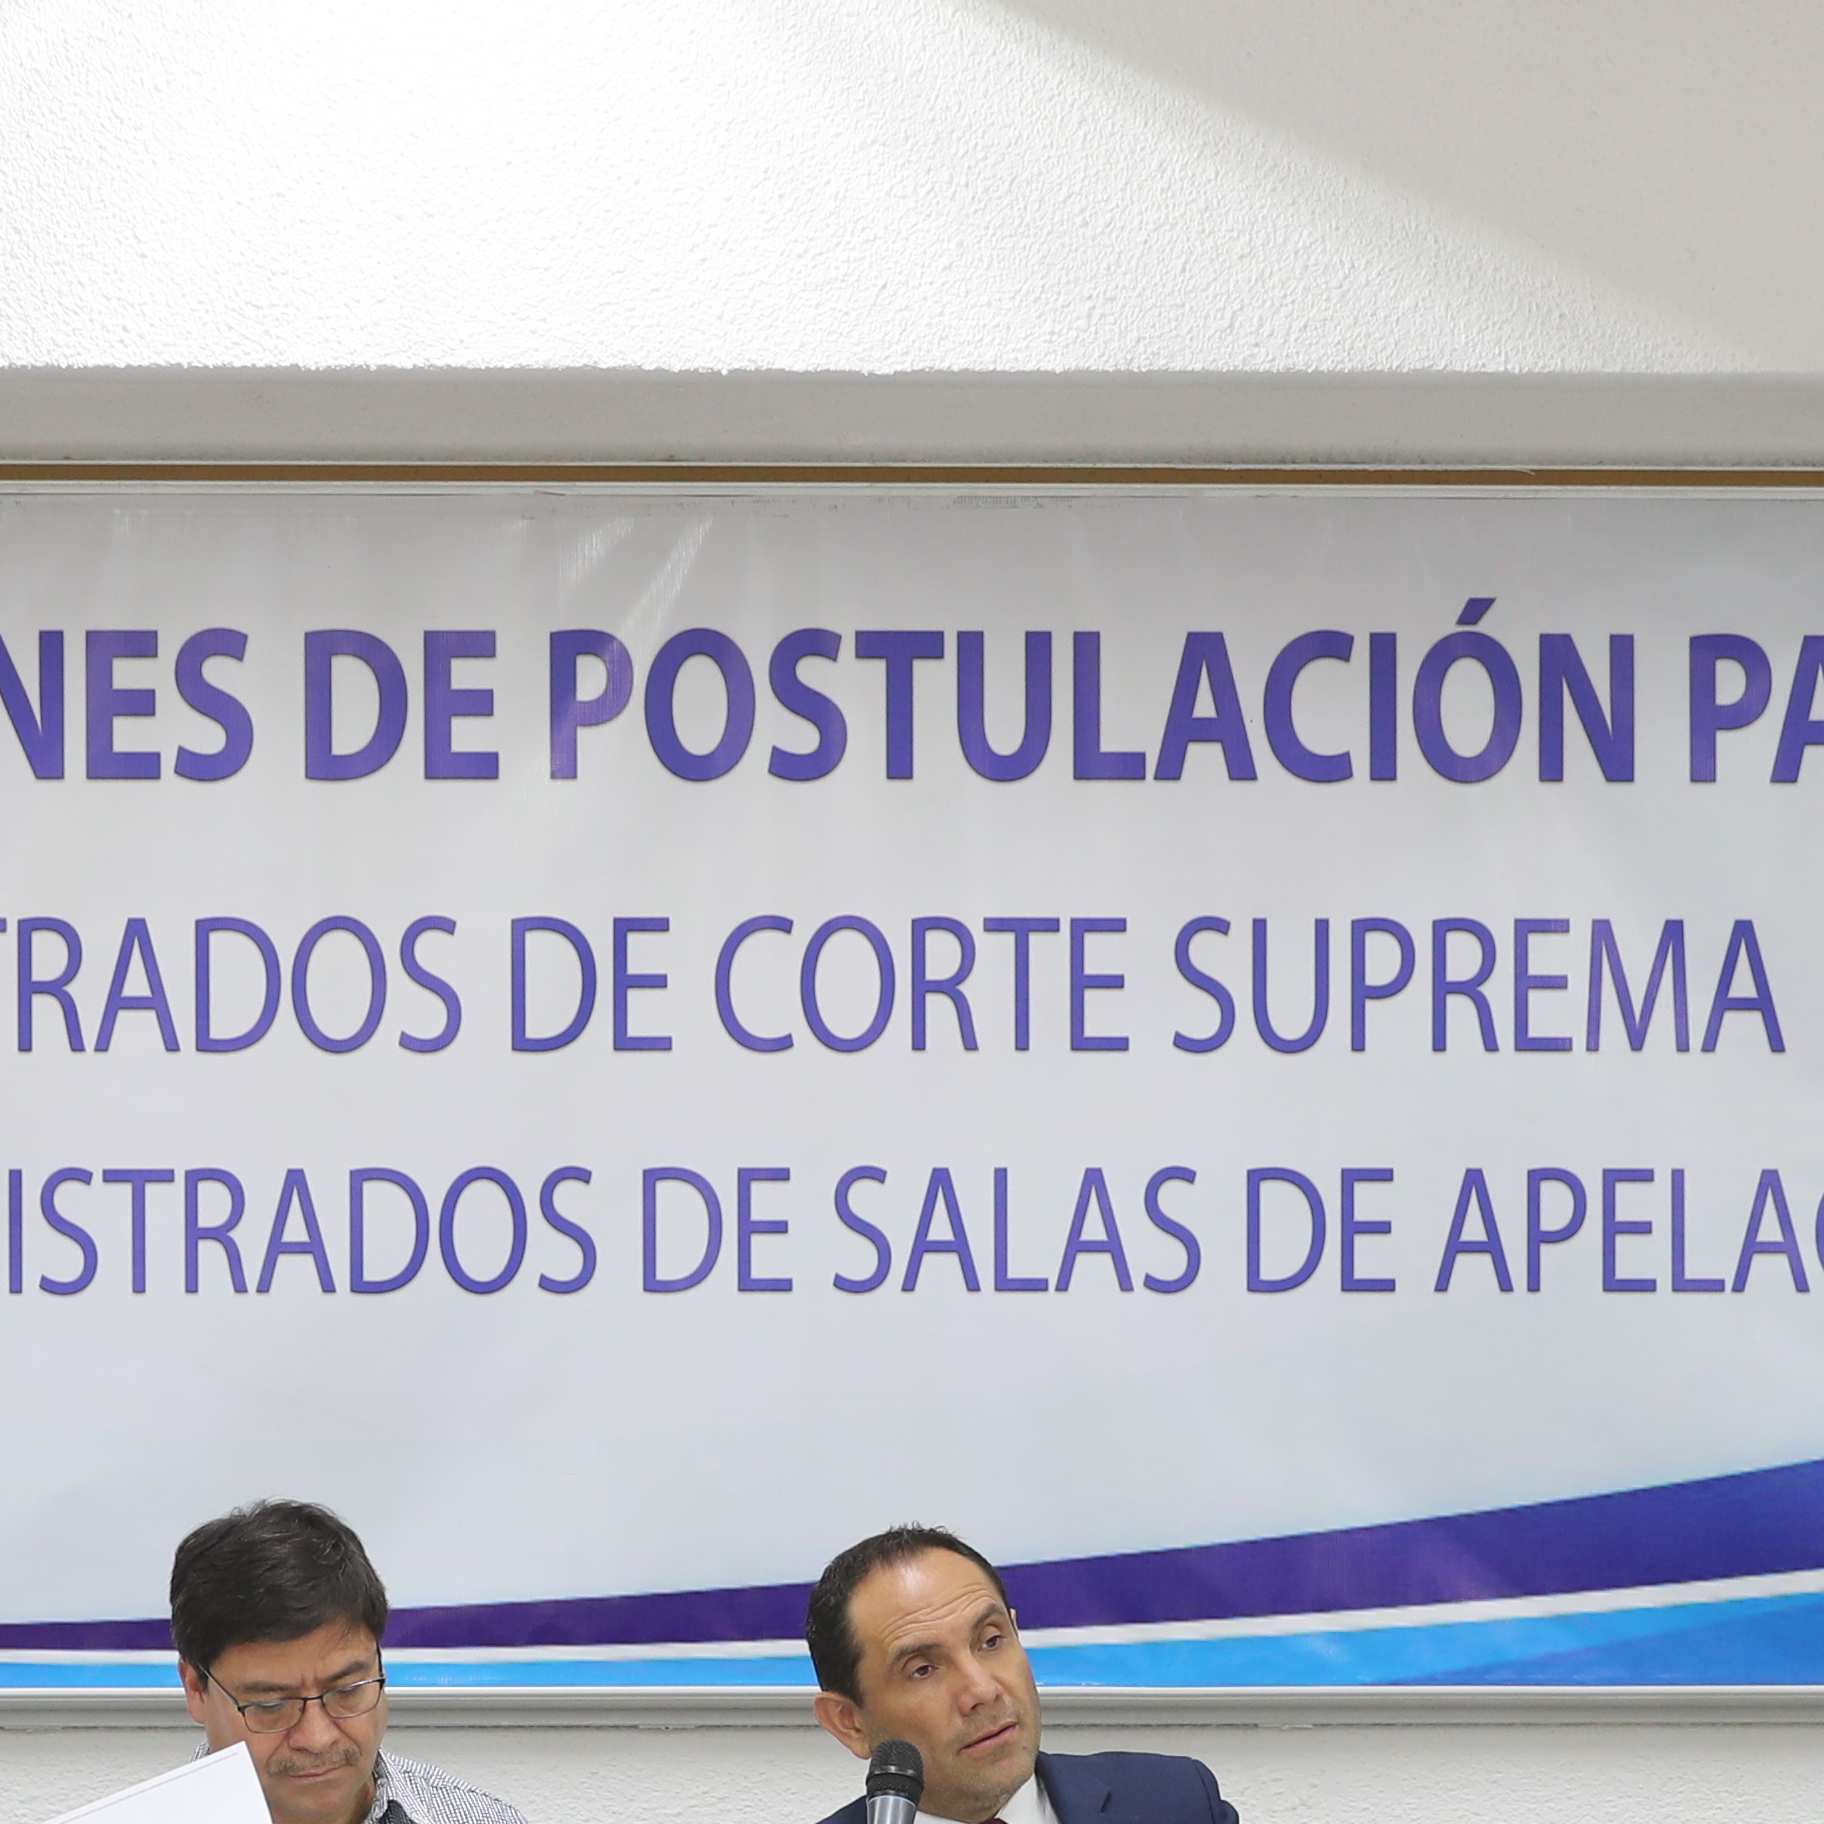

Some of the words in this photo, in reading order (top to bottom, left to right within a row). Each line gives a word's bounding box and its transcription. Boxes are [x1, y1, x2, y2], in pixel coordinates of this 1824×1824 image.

[304, 628, 500, 781] DE
[549, 596, 1636, 784] POSTULACIÓN
[510, 915, 673, 1053] DE
[714, 914, 1130, 1053] CORTE
[1172, 915, 1786, 1055] SUPREMA
[642, 1166, 794, 1294] DE
[832, 1165, 1202, 1295] SALAS
[1246, 1166, 1397, 1294] DE
